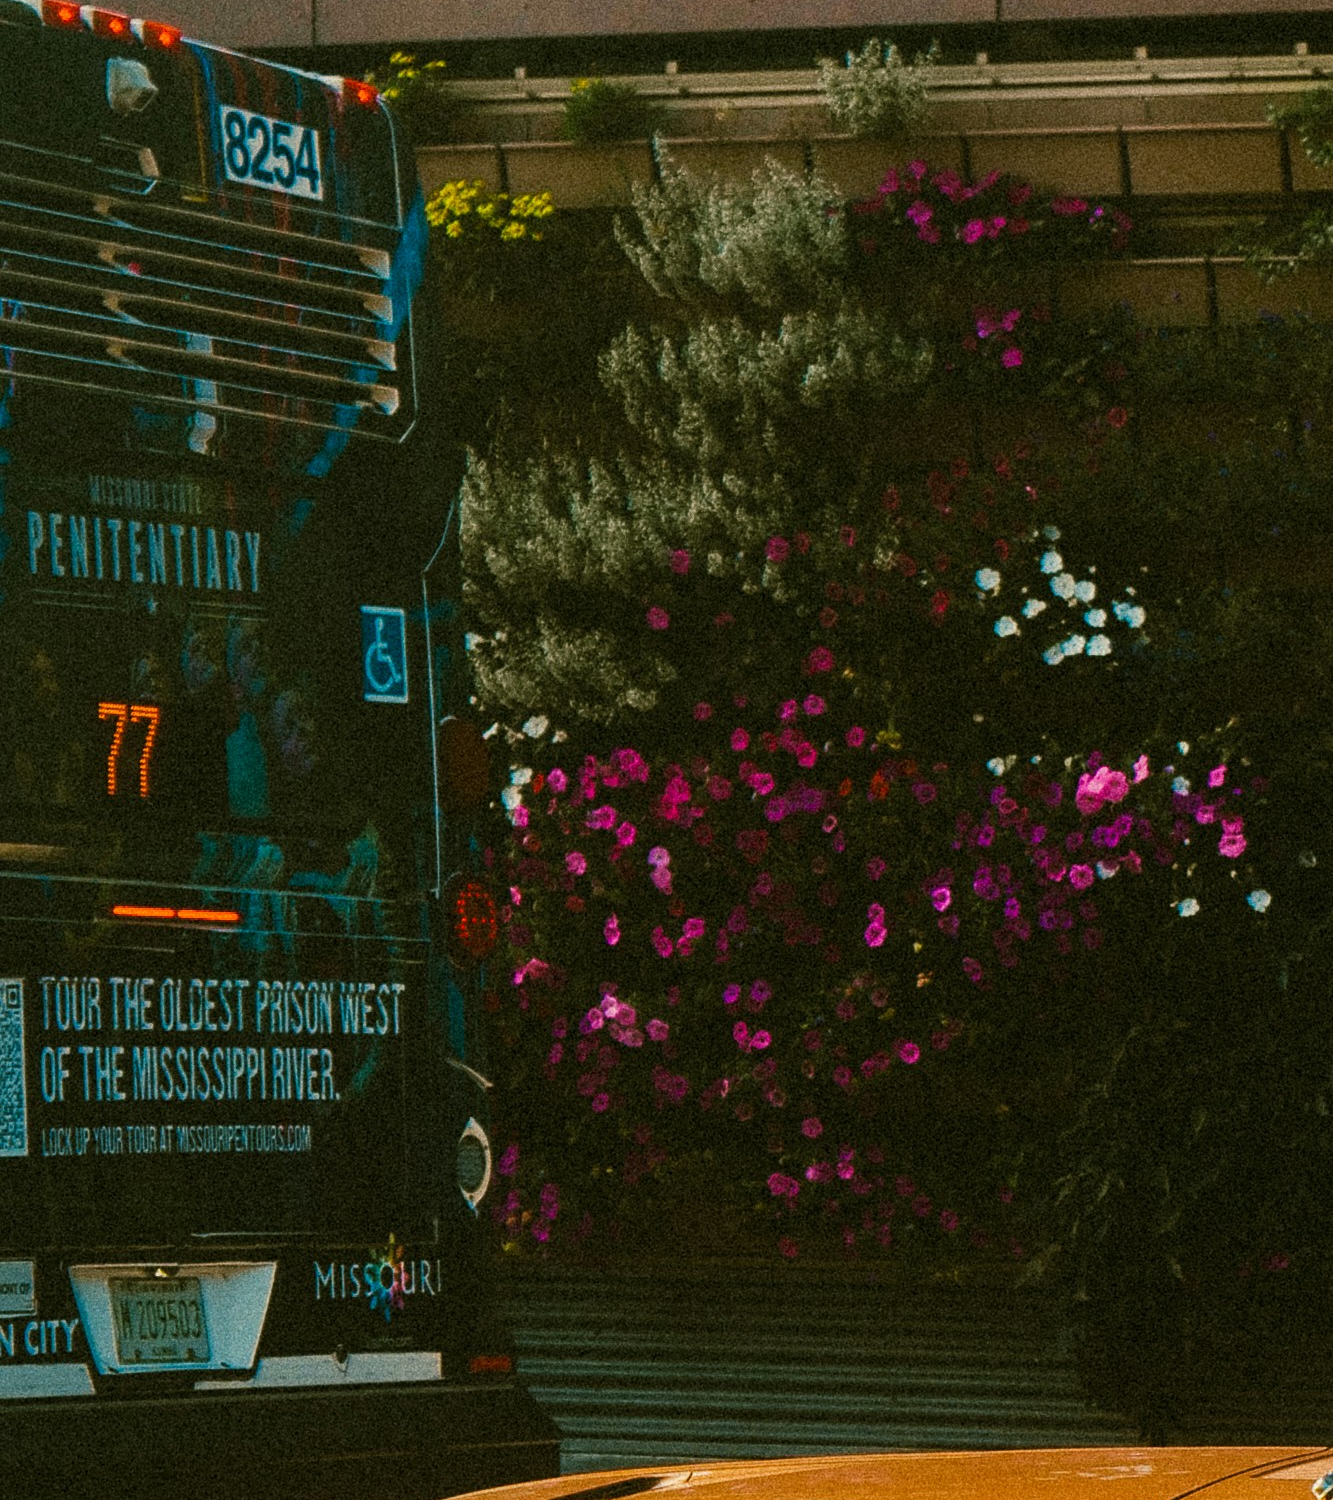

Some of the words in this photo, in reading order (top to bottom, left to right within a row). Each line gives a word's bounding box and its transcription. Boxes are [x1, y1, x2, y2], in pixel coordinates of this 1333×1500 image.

[225, 111, 319, 193] 8254
[27, 510, 260, 593] PENITENTIARY
[99, 703, 159, 798] 77
[38, 977, 101, 1031] TOUR
[108, 978, 155, 1031] THE
[159, 979, 250, 1033] OLDEST
[256, 980, 334, 1034] PRISON
[340, 982, 405, 1035] WEST
[40, 1046, 71, 1103] OF
[79, 1045, 126, 1101] THE
[132, 1046, 267, 1102] MISSISSIPPI
[273, 1047, 341, 1101] RIVER.
[42, 1126, 73, 1157] LOCK
[75, 1126, 90, 1156] UP
[93, 1125, 123, 1155] YOUR
[126, 1125, 157, 1154] TOUR
[160, 1124, 173, 1153] AT
[313, 1260, 442, 1300] MISSOURI
[24, 1318, 79, 1356] CITY
